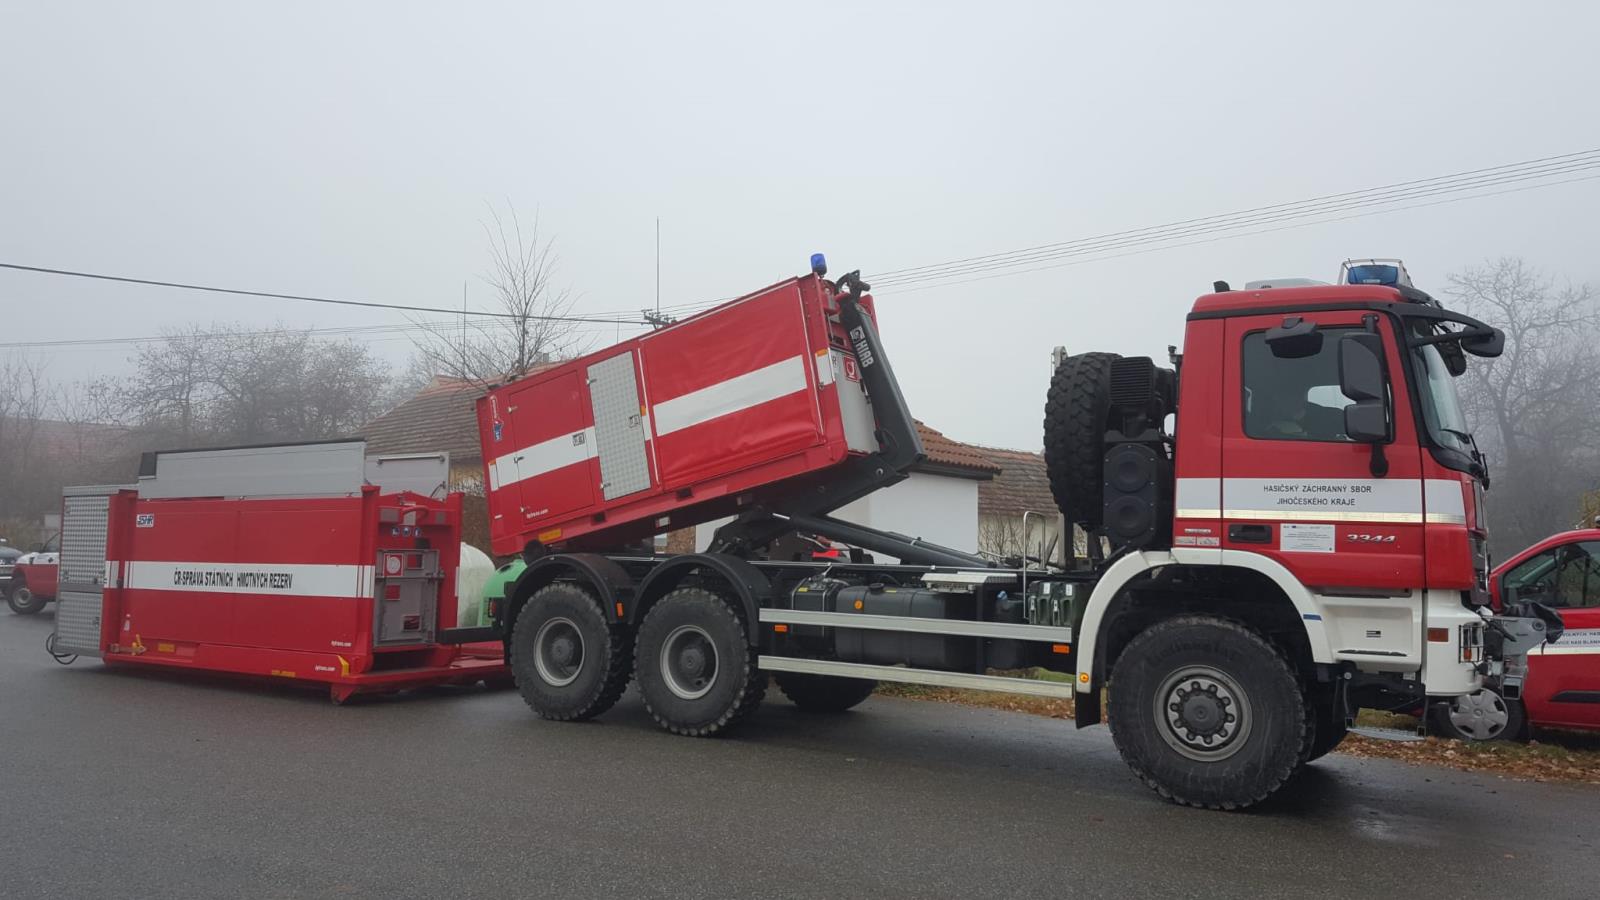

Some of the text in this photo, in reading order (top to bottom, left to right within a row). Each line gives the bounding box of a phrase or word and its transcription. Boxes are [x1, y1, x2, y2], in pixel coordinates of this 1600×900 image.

[855, 339, 875, 368] HIAB
[1263, 484, 1372, 493] HASIČSKÝ ZÁCHRANNÝ SBOR
[1277, 496, 1356, 506] JIHOČESKÉHO KRAJE
[1347, 534, 1396, 543] 3344
[205, 568, 234, 587] STÁTNÍCH
[236, 569, 268, 588] HMOTNÝCH
[269, 573, 293, 589] REZERV
